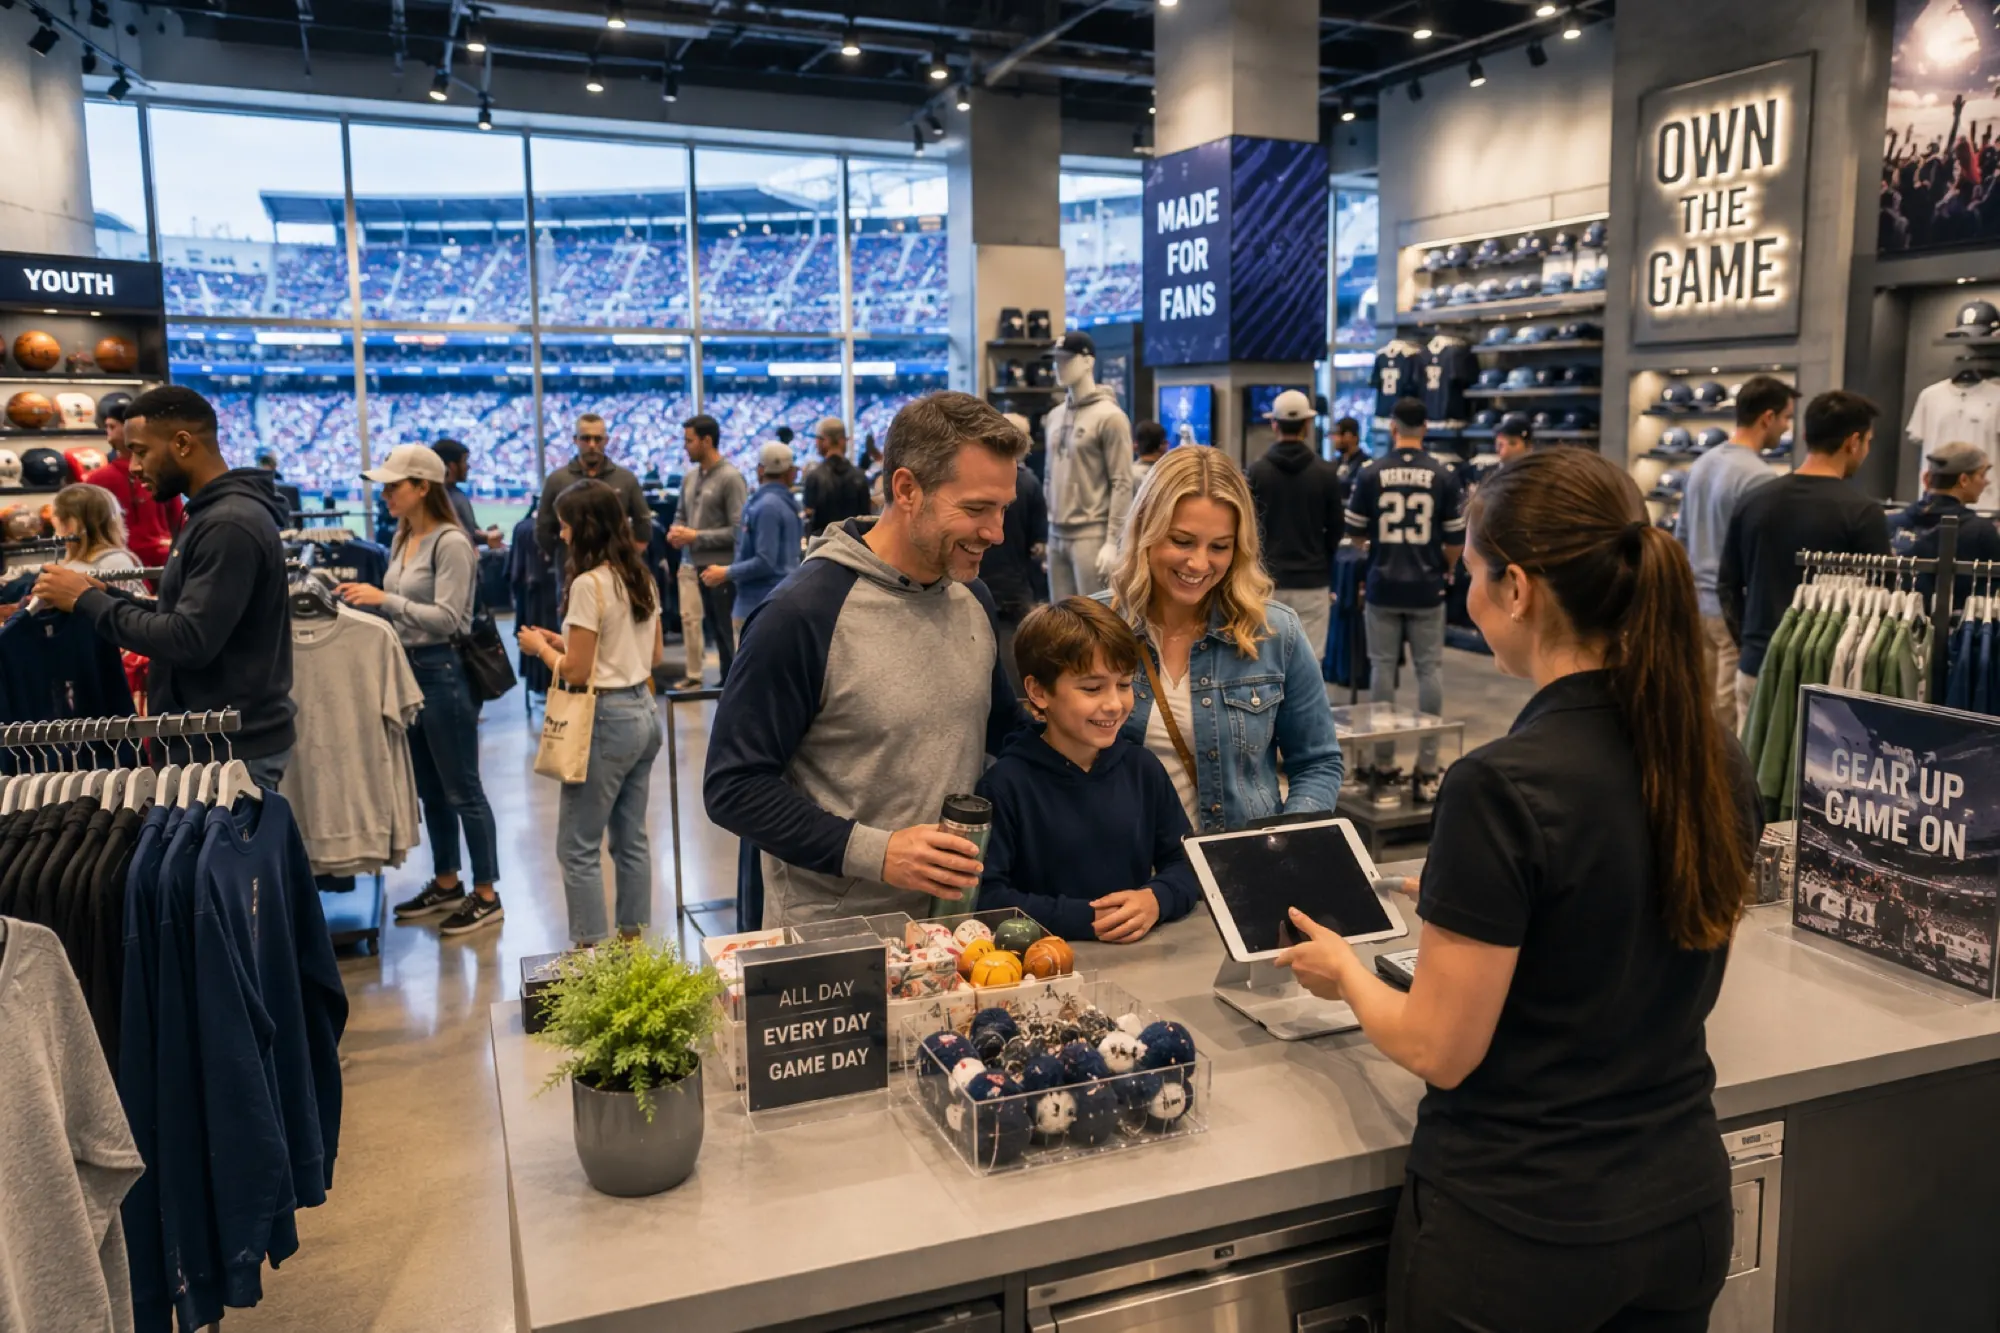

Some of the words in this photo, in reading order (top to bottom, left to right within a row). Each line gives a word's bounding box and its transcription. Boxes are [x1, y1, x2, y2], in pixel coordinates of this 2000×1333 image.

[1657, 99, 1777, 184] OWN
[1157, 187, 1220, 234] MADE
[1680, 186, 1747, 234] THE
[1167, 237, 1209, 276] FOR
[1649, 237, 1778, 308] GAME
[24, 268, 115, 296] YOUTH
[1159, 281, 1216, 321] FANS
[1378, 492, 1434, 545] 23
[1831, 749, 1910, 800] GEAR
[1919, 767, 1965, 809] UP
[1825, 791, 1909, 846] GAME
[1919, 815, 1967, 861] ON
[779, 987, 812, 1008] ALL
[819, 979, 855, 1001] DAY
[763, 1018, 828, 1046] EVERY
[833, 1012, 871, 1035] DAY
[769, 1055, 825, 1082] GAME
[832, 1047, 869, 1070] DAY
